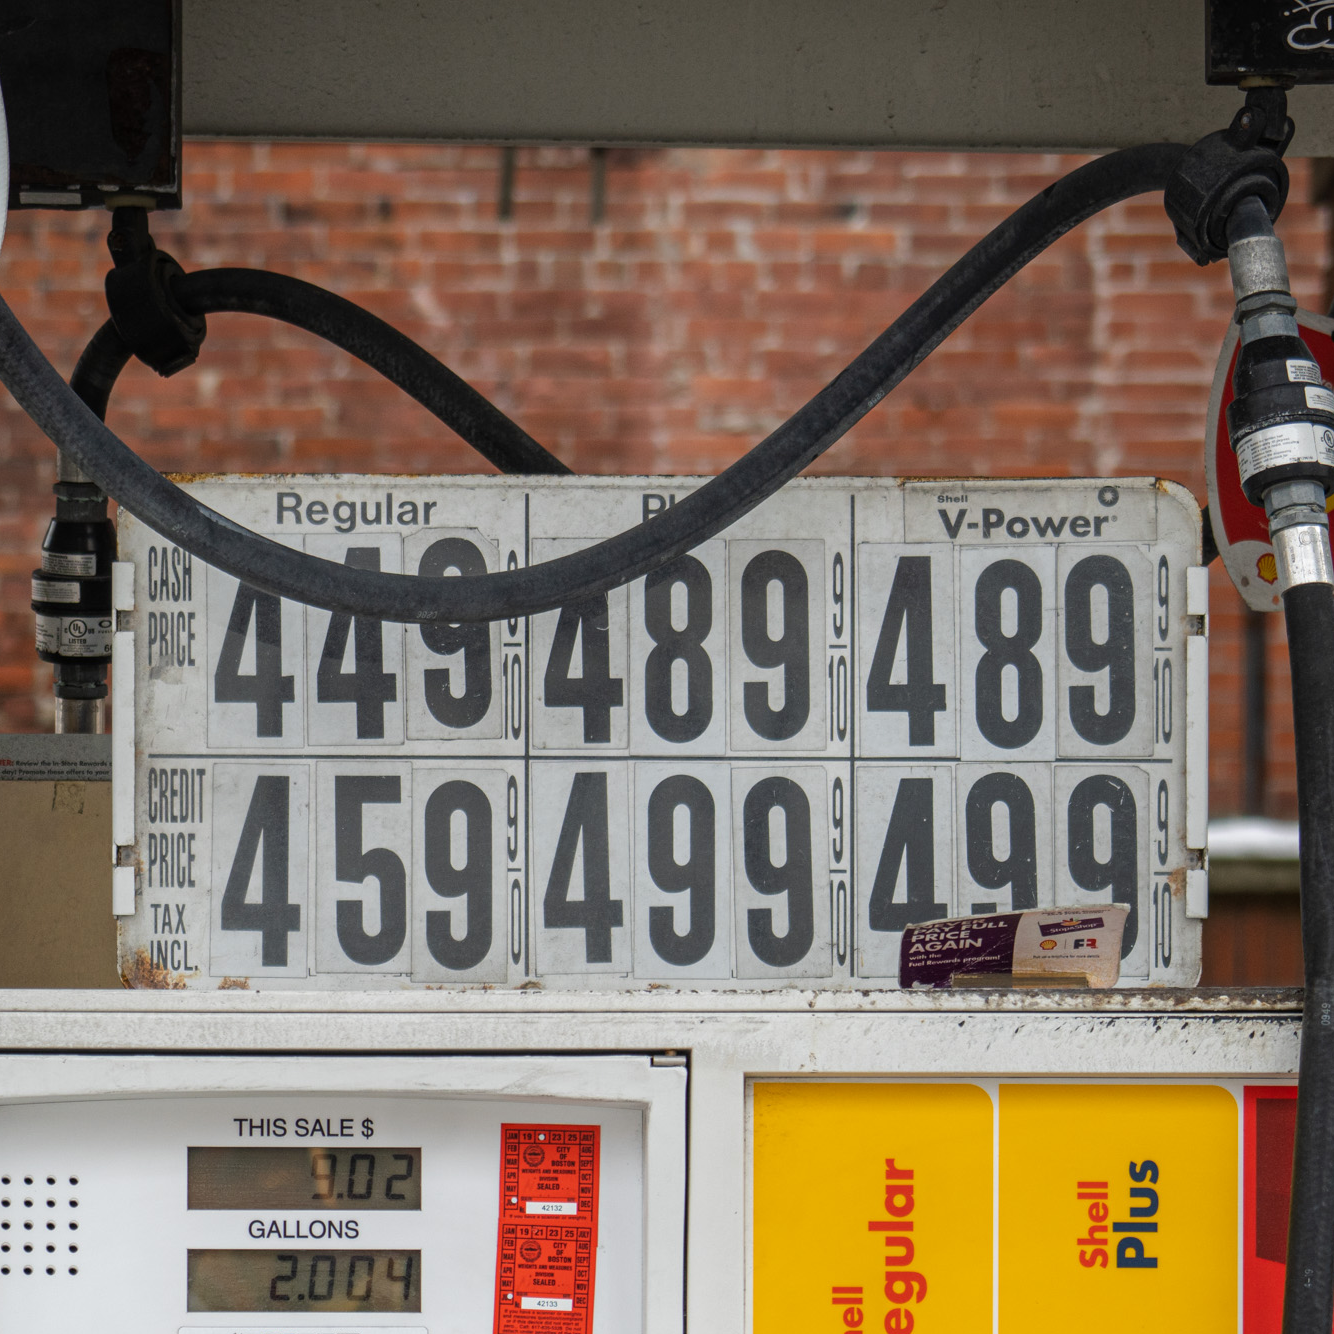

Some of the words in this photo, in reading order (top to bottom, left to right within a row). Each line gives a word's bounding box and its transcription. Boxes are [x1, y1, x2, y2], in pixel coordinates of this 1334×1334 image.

[275, 492, 438, 533] Regular
[937, 494, 969, 504] Shell
[148, 546, 192, 603] CASH
[148, 612, 196, 667] PRICE
[148, 769, 206, 824] CREDIT
[148, 833, 196, 888] PRICE
[151, 904, 186, 935] TAX
[911, 930, 970, 943] PRICE
[149, 940, 199, 972] INCL.
[909, 939, 982, 954] AGAIN
[234, 1118, 289, 1137] THIS
[294, 1118, 354, 1137] SALE
[361, 1116, 374, 1139] $
[248, 1219, 359, 1239] GALLONS
[1077, 1181, 1109, 1269] Shell
[1117, 1159, 1160, 1269] Plus
[270, 1254, 414, 1301] 2.004
